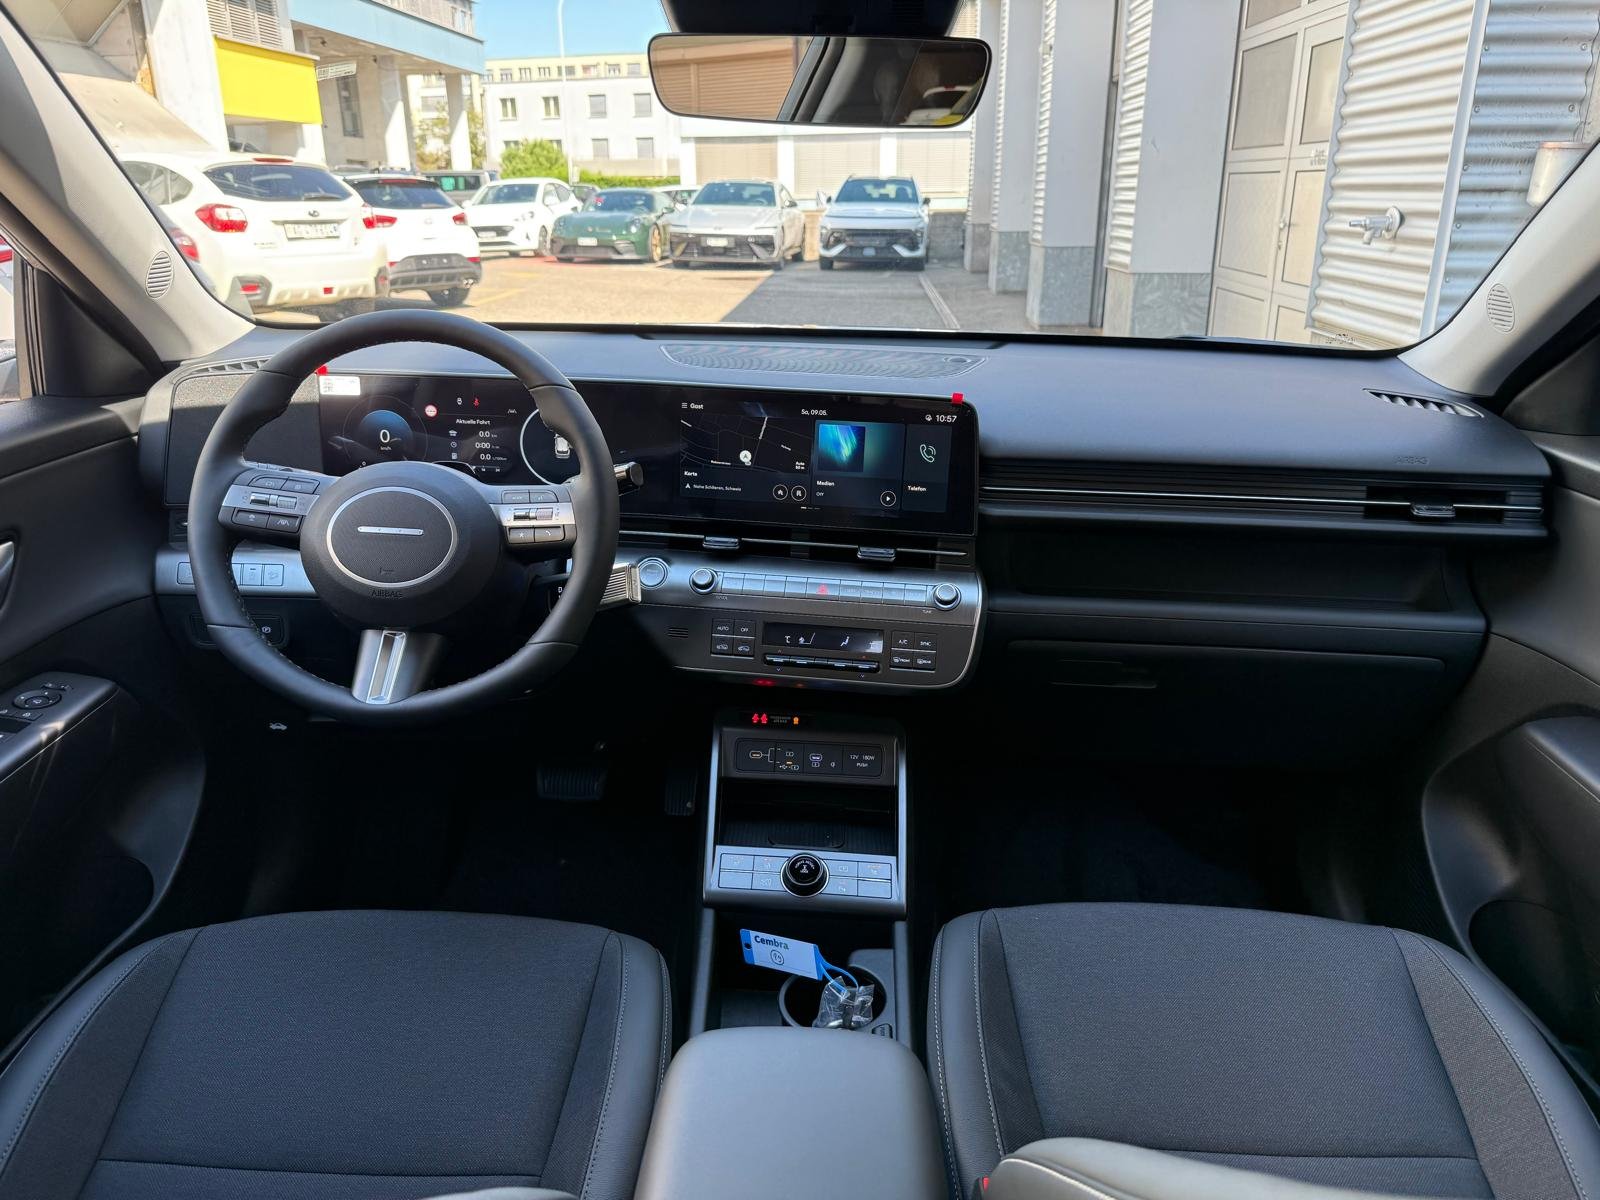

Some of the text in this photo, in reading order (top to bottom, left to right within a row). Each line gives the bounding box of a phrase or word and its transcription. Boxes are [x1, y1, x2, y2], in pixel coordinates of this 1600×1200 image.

[690, 402, 704, 410] Gast
[935, 414, 958, 423] 10:57
[380, 429, 391, 443] 0
[479, 430, 490, 438] 0.0
[475, 441, 491, 449] 0:00
[480, 453, 492, 461] 0.0
[371, 589, 404, 599] AIRBAG
[754, 935, 790, 950] Cembra
